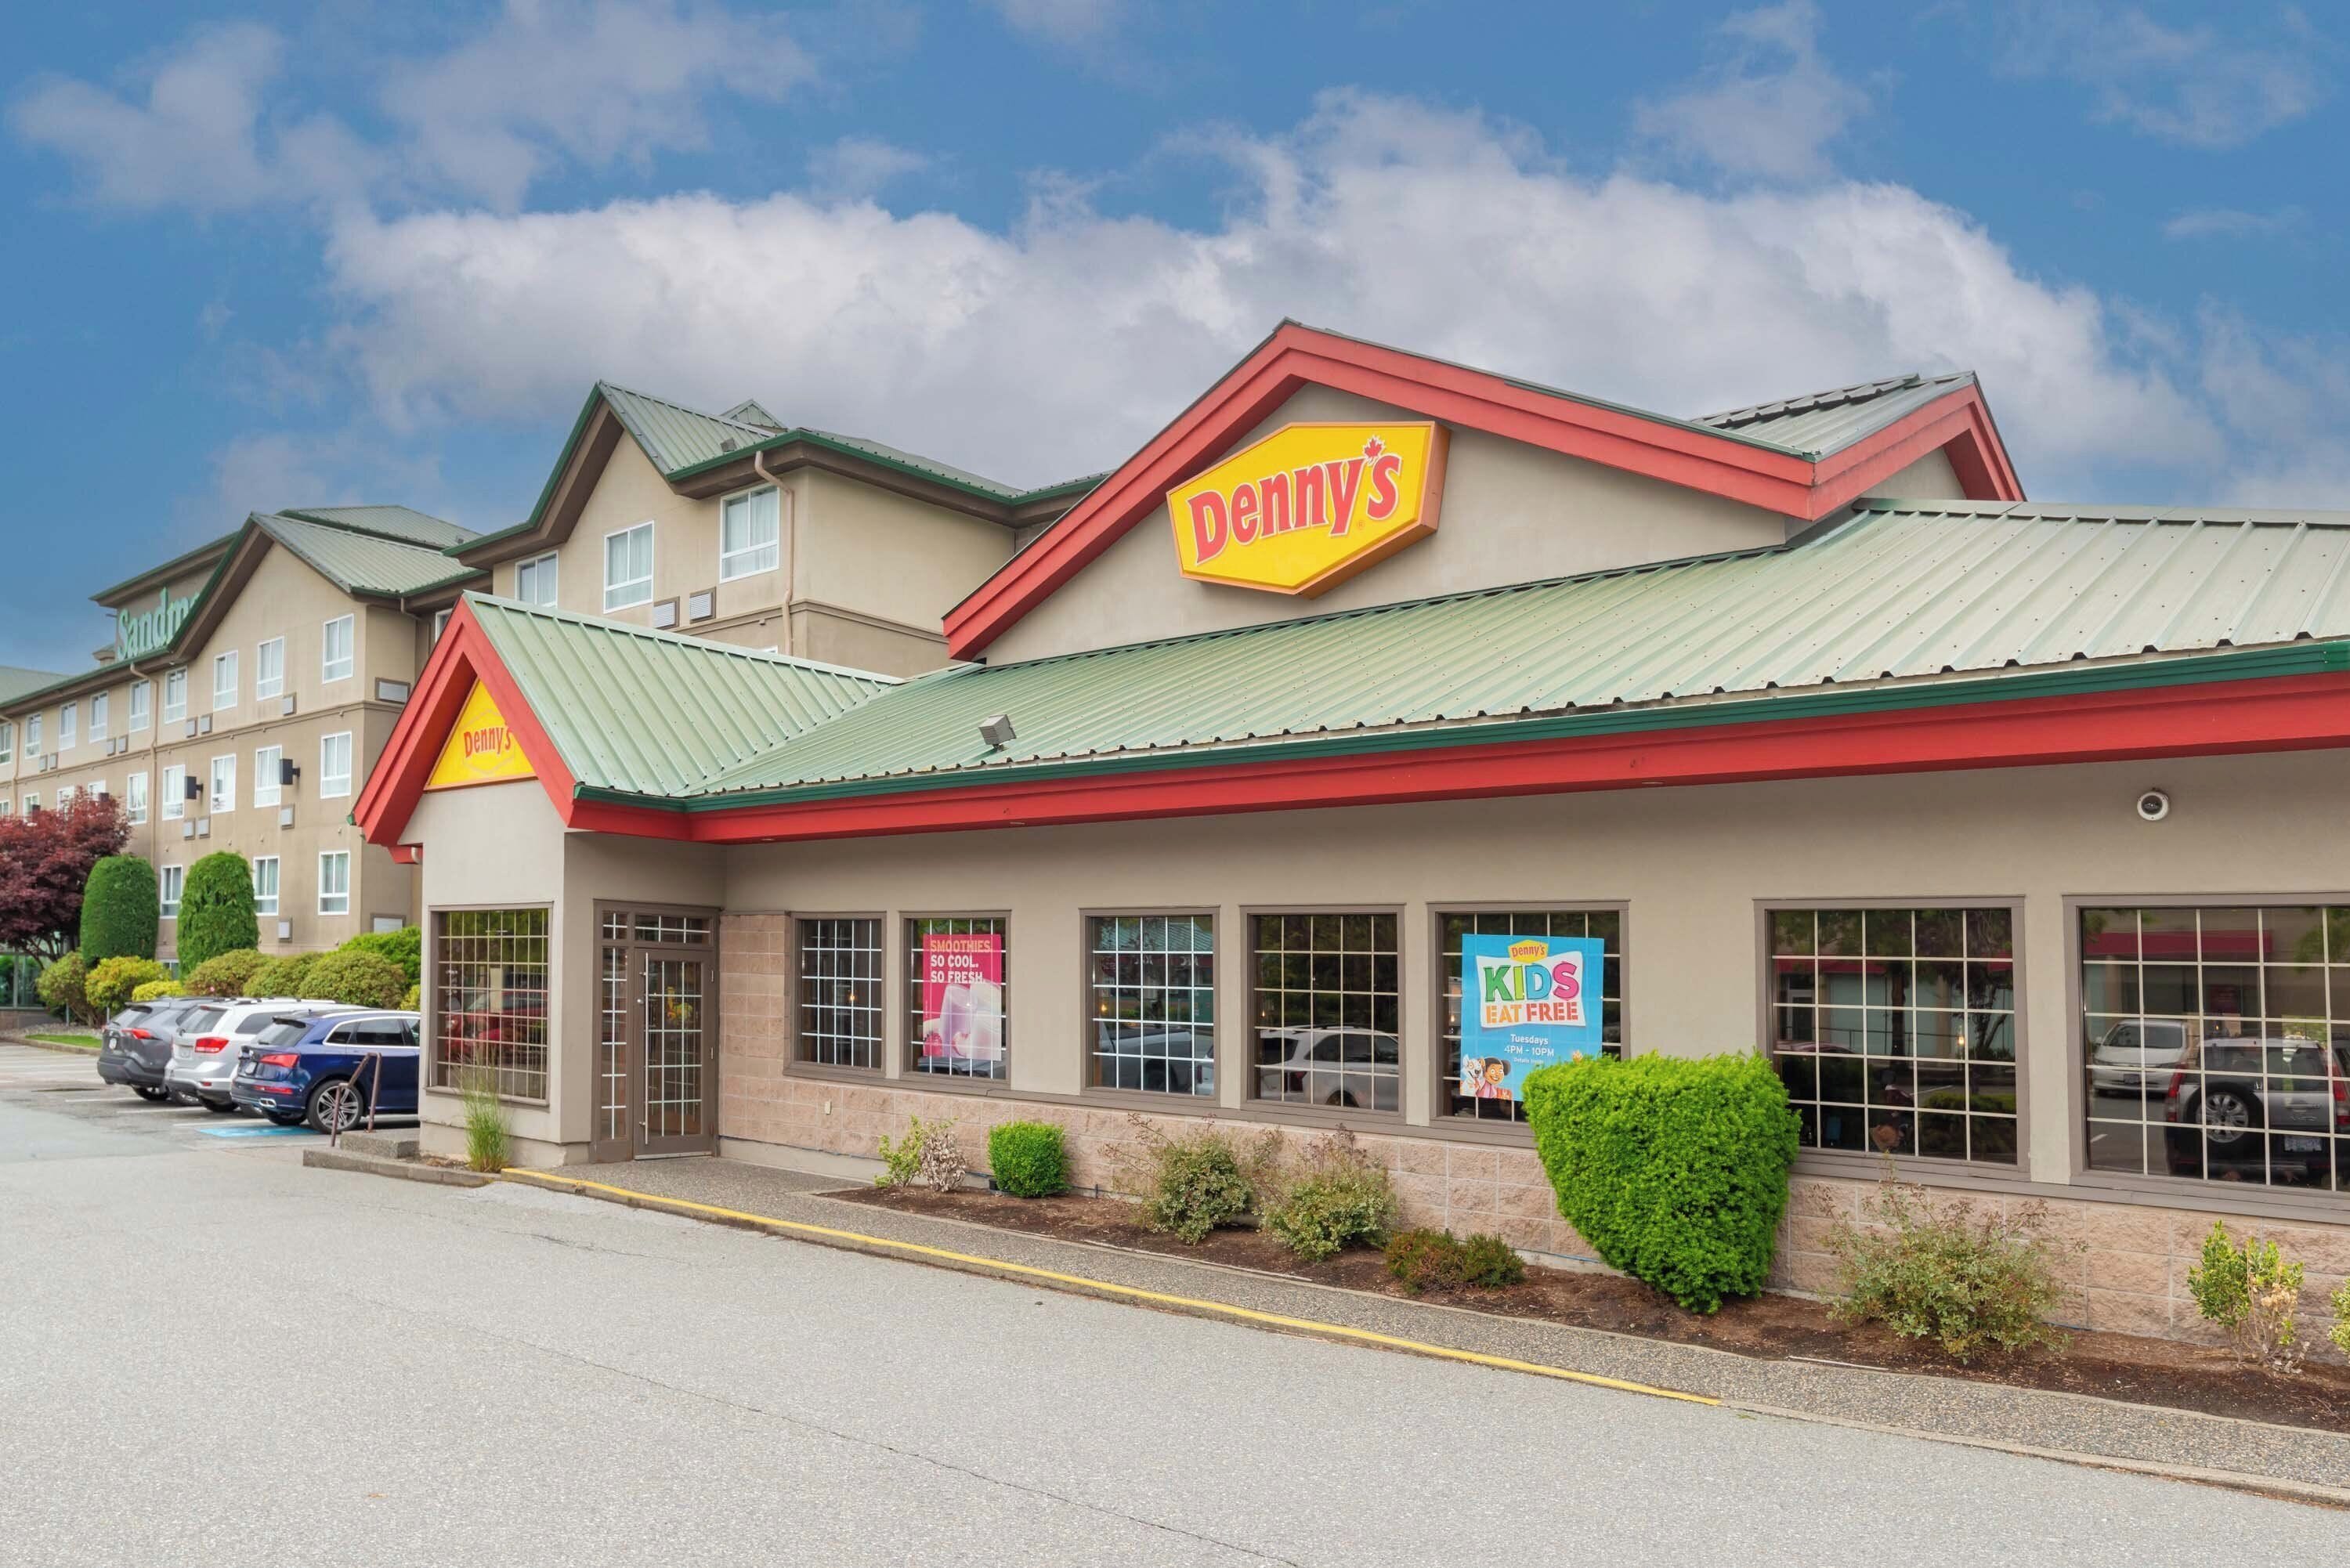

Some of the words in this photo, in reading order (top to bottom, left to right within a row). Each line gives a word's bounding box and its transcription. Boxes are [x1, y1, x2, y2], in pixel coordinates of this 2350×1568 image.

[1188, 453, 1402, 565] Denny's
[1511, 945, 1546, 958] Denny's
[931, 955, 945, 967] SO
[948, 955, 978, 968] COOL.
[931, 970, 945, 983] SO
[1483, 961, 1580, 1003] KIDS
[1485, 1004, 1522, 1024] EAT
[1526, 1002, 1578, 1022] FREE
[1510, 1034, 1549, 1046] Tuesdays
[1504, 1046, 1523, 1054] 4PM
[1531, 1047, 1555, 1057] 10PM
